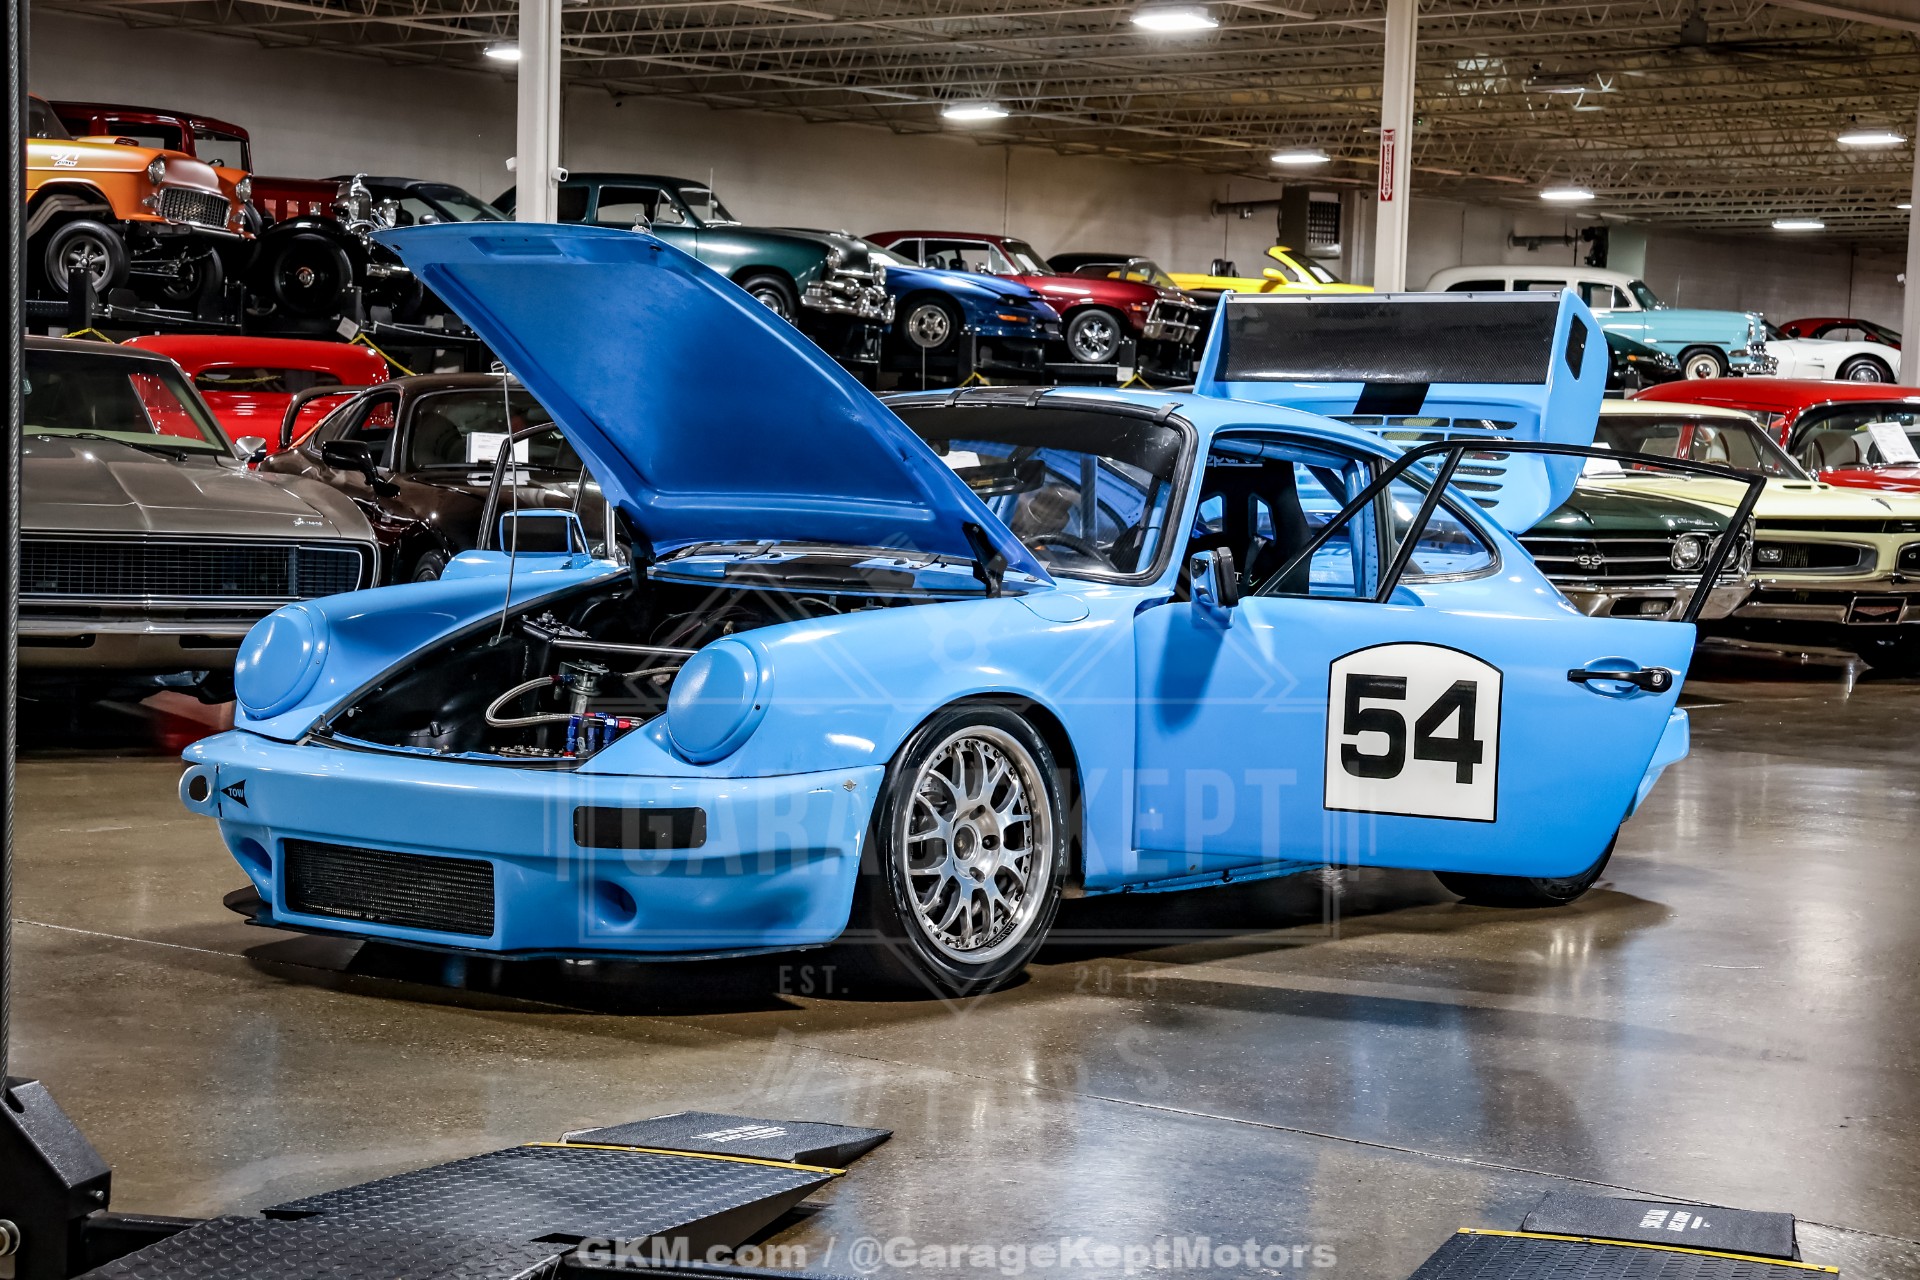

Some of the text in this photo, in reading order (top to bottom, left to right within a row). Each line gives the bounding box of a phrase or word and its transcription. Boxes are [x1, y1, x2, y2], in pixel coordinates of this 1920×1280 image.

[1579, 555, 1602, 566] SS
[1341, 673, 1483, 784] 54
[228, 788, 244, 798] TOW
